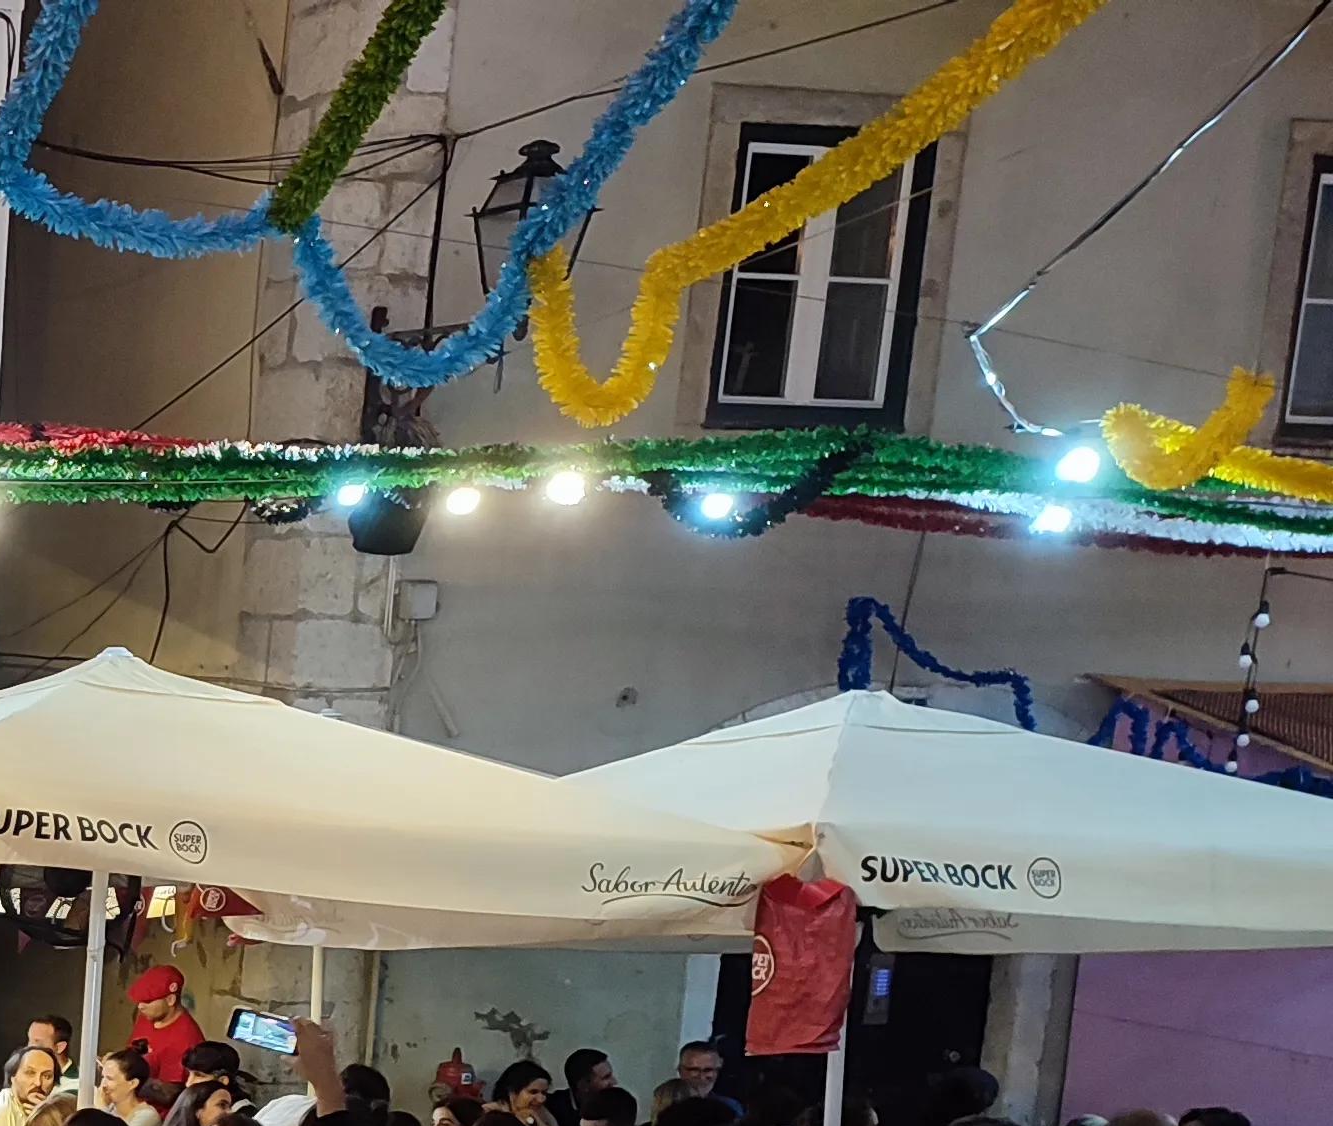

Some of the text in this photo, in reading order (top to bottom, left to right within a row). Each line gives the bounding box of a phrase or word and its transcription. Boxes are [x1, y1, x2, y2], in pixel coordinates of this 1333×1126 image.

[77, 815, 159, 850] BOCK
[174, 833, 202, 844] SUPER
[176, 842, 201, 854] BOCK
[581, 863, 656, 893] Sabor
[861, 856, 1017, 890] SUPER BOCK
[1032, 869, 1056, 879] SUPER
[1034, 878, 1055, 887] BOCK
[752, 966, 768, 980] CK
